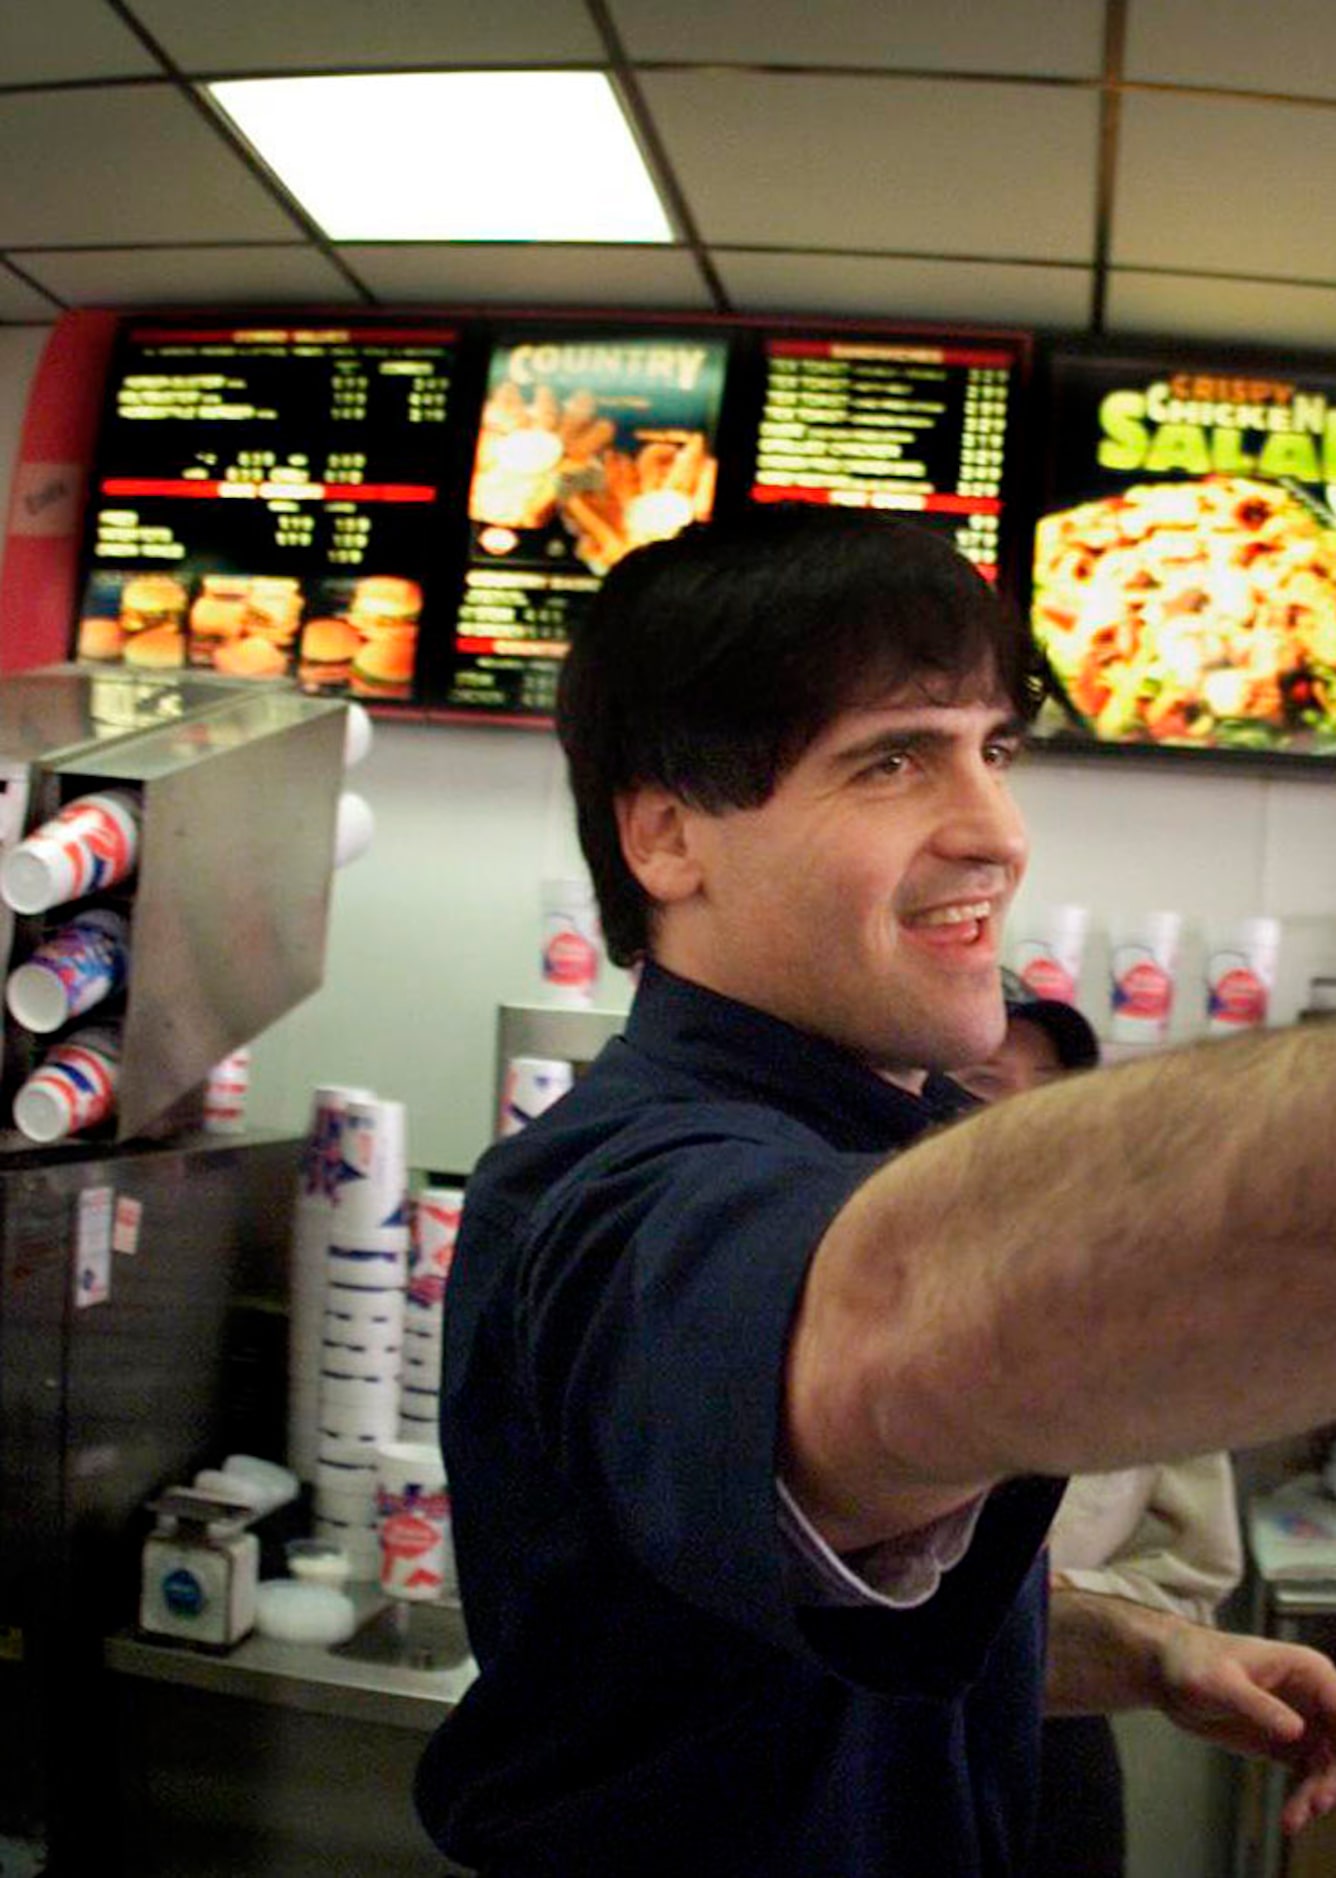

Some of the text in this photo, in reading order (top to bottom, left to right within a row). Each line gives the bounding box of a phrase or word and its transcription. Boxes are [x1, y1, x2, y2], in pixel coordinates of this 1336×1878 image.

[509, 343, 706, 390] COUNTRY
[1170, 374, 1295, 405] CRISPY
[1146, 382, 1327, 434] CHICKEN
